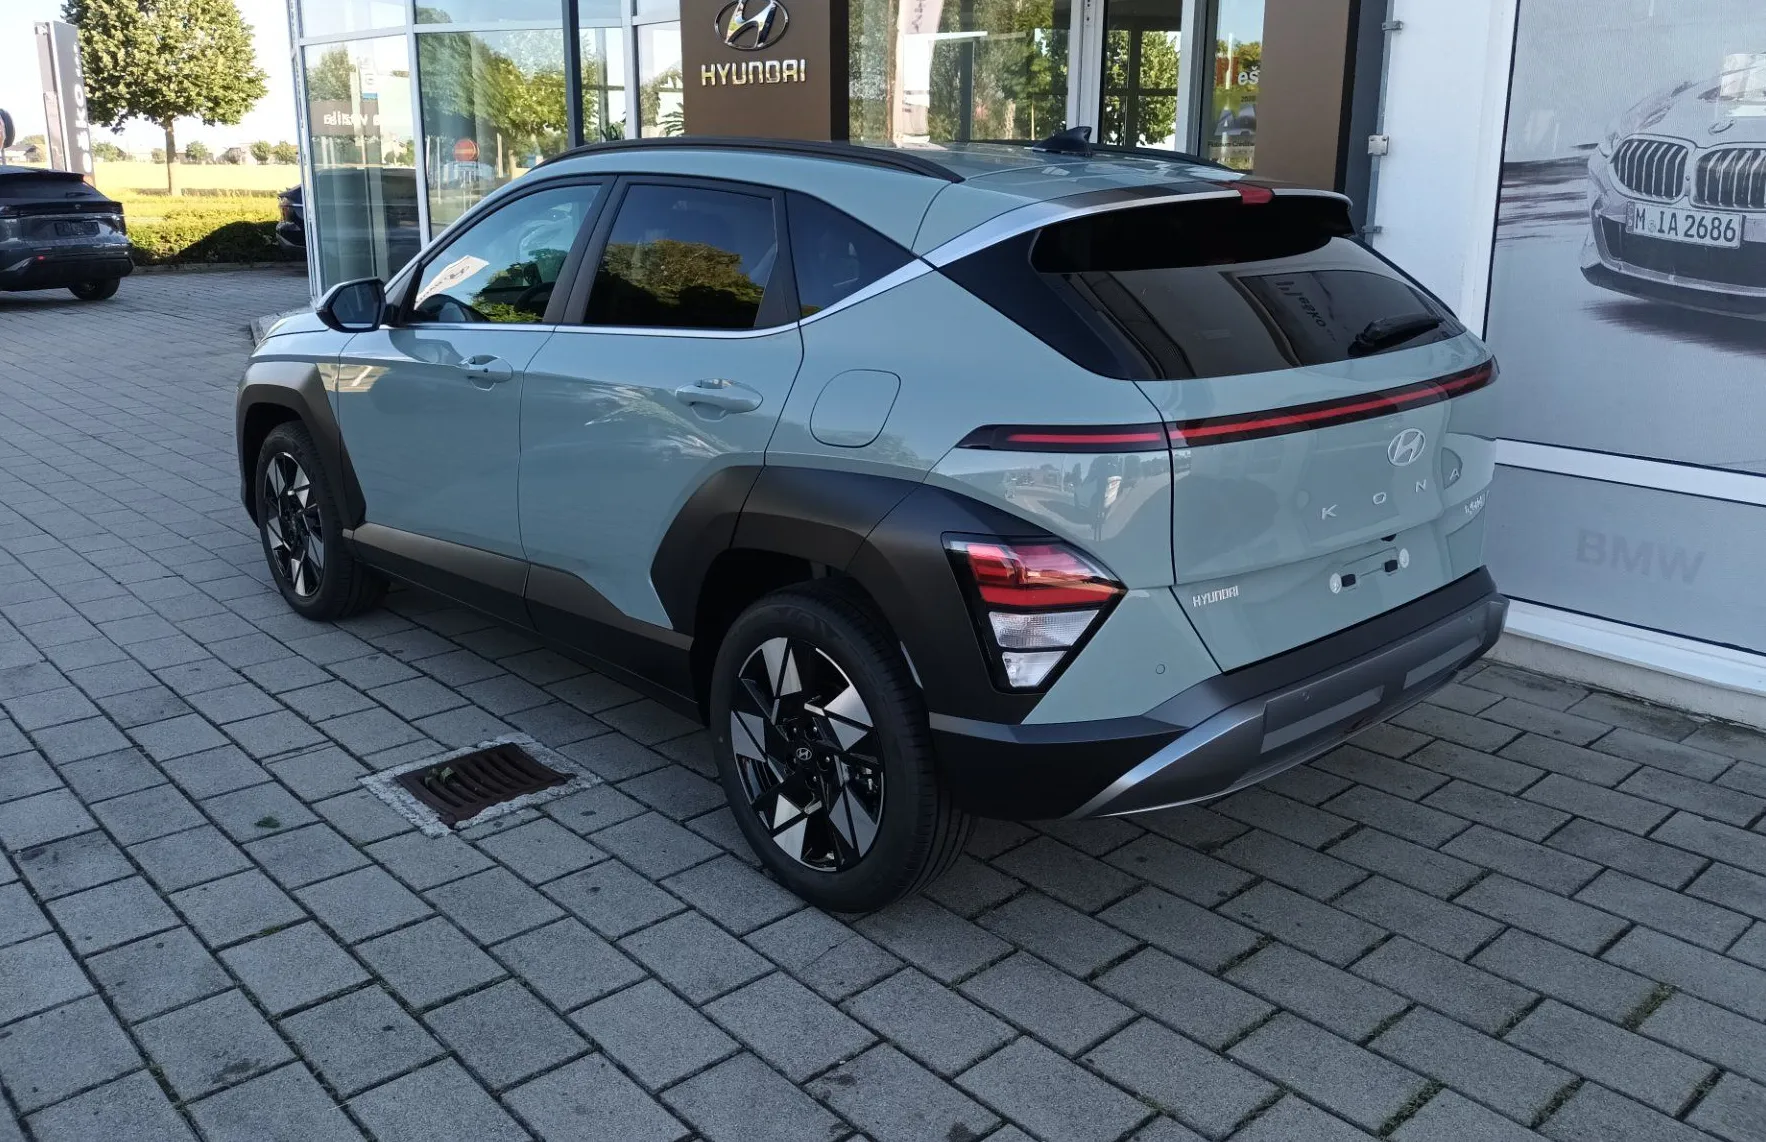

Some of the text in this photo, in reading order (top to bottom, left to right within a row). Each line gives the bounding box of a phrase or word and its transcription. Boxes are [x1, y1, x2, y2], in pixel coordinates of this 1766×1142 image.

[701, 59, 806, 86] HYUNDAI
[1635, 207, 1736, 242] M IA 2686
[1321, 468, 1460, 520] KONA
[1576, 528, 1706, 585] BMW
[1192, 585, 1240, 607] HYUNDAI
